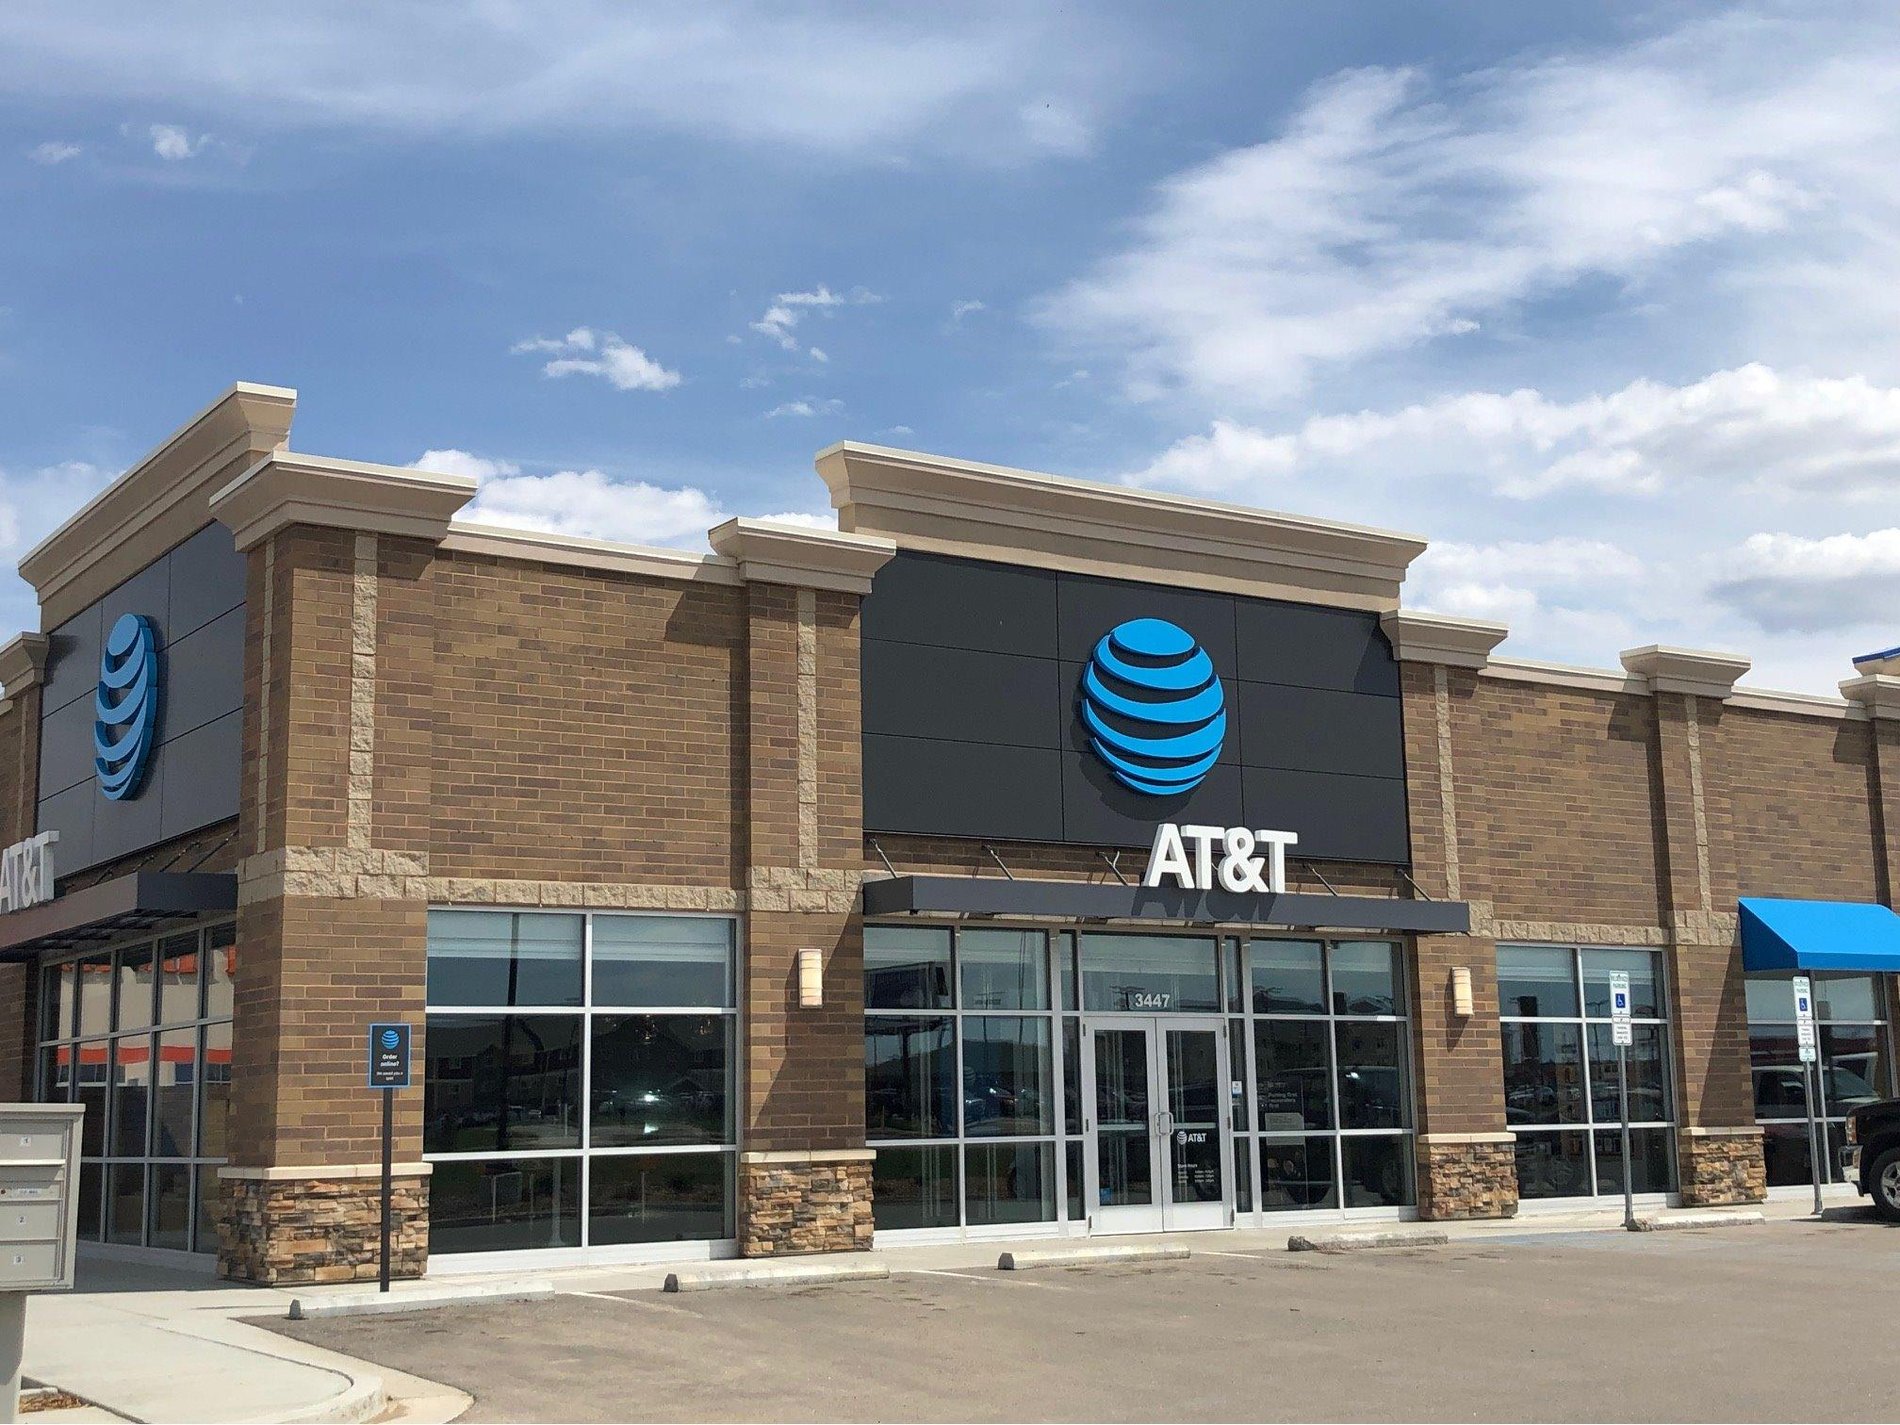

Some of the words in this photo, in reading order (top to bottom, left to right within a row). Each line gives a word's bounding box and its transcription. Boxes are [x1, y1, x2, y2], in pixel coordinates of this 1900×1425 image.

[0, 830, 60, 915] AT&T
[1142, 823, 1298, 894] AT&T
[1135, 993, 1170, 1008] 3447
[1187, 1133, 1207, 1142] AT&T
